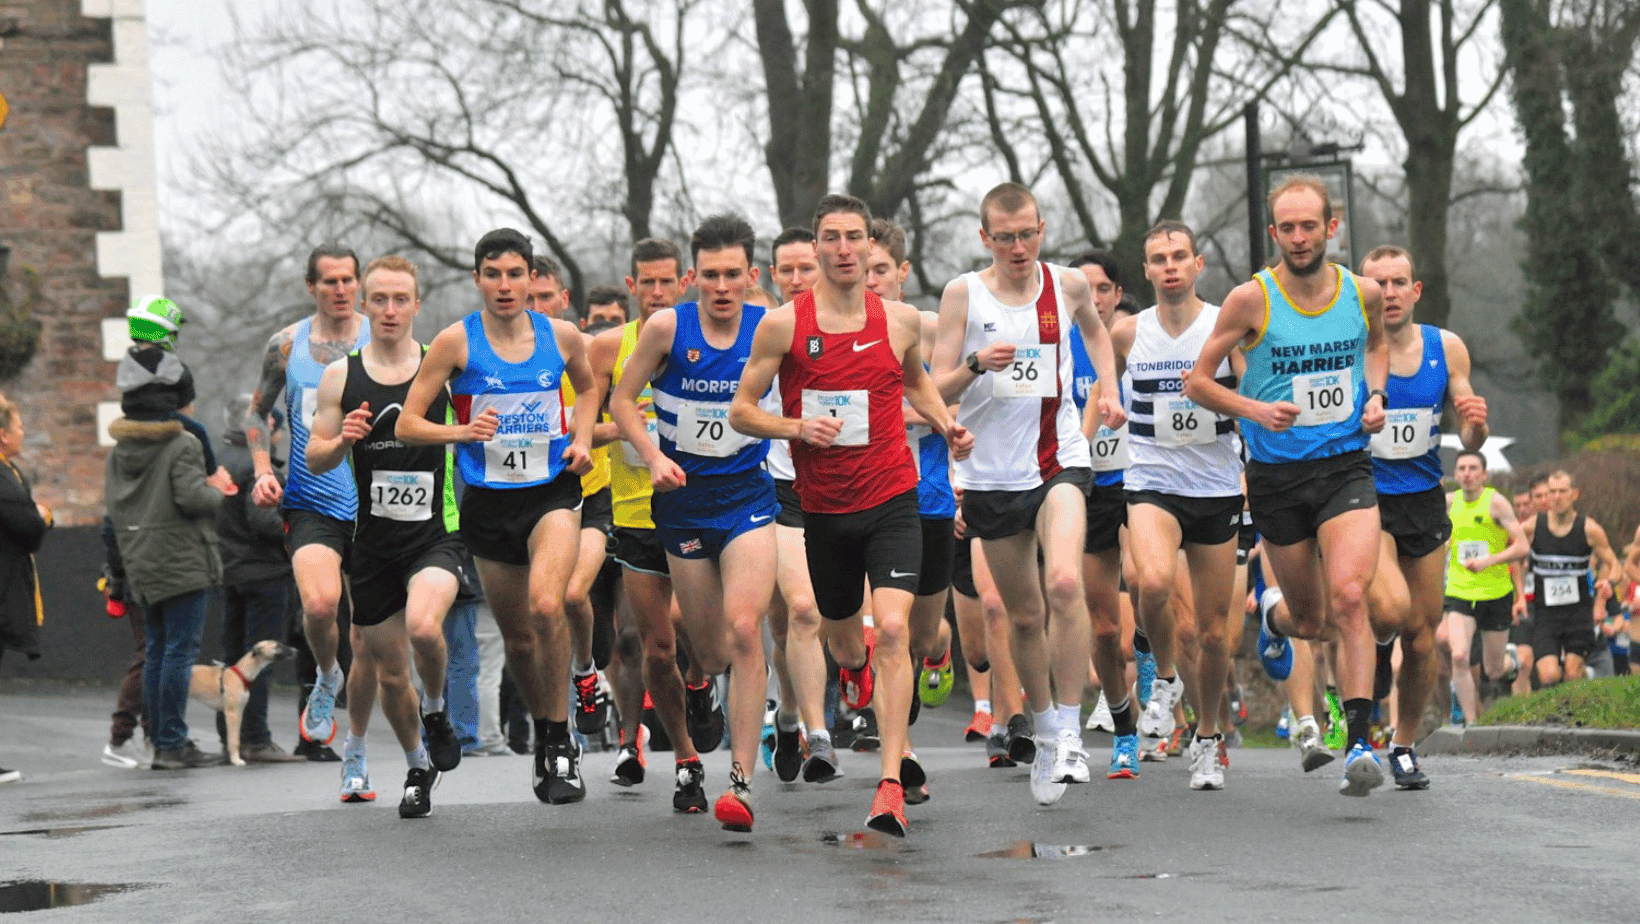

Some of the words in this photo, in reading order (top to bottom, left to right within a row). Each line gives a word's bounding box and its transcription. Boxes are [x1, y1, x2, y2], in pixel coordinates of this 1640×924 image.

[1271, 345, 1305, 357] NEW
[1012, 361, 1038, 381] 56
[1136, 360, 1196, 372] TONBRIDG
[1308, 387, 1344, 410] 100
[696, 420, 724, 441] 70
[1172, 412, 1198, 431] 86
[1392, 425, 1415, 443] 10
[502, 451, 526, 470] 41
[377, 486, 427, 506] 1262
[1551, 585, 1572, 596] 254
